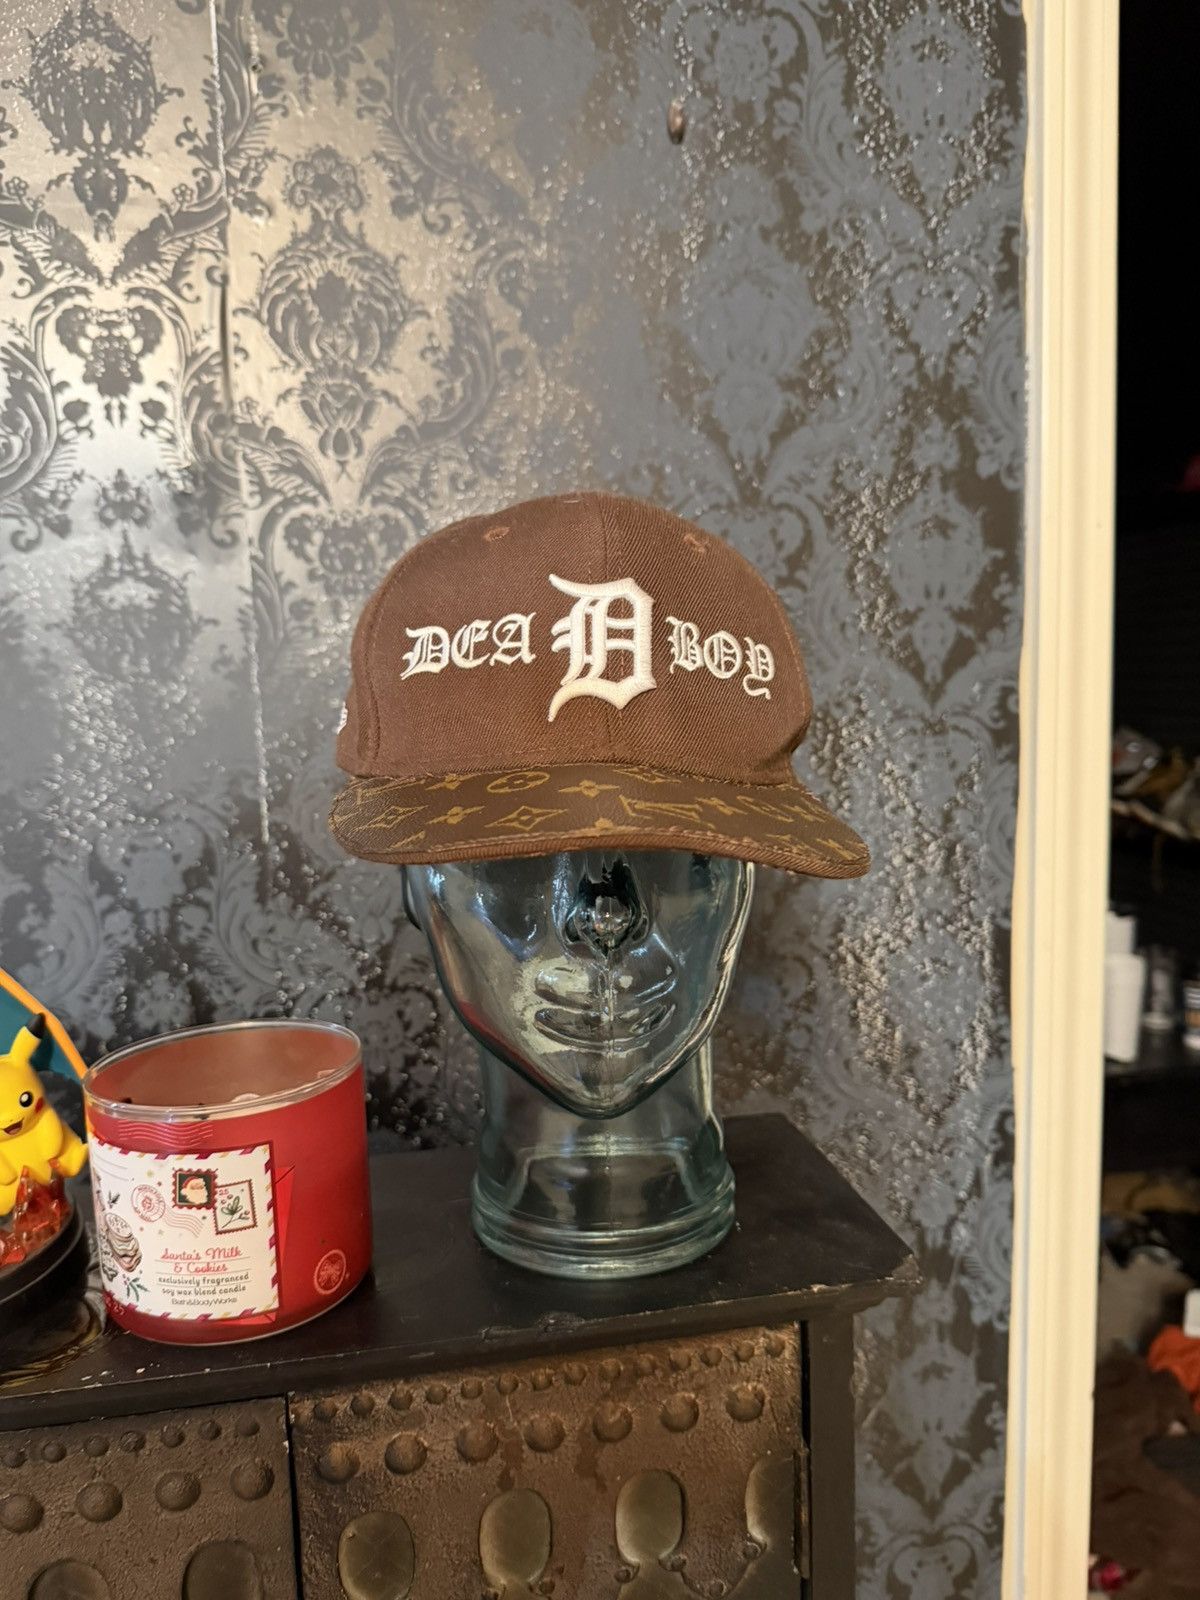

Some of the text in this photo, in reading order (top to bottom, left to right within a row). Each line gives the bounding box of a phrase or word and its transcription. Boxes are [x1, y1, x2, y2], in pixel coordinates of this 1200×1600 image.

[161, 1246, 242, 1261] Santa's Milk
[173, 1262, 228, 1273] & Cookies
[158, 1272, 249, 1287] exclusively fragranced
[162, 1288, 175, 1297] soy
[194, 1287, 217, 1296] blend
[218, 1284, 246, 1295] candle
